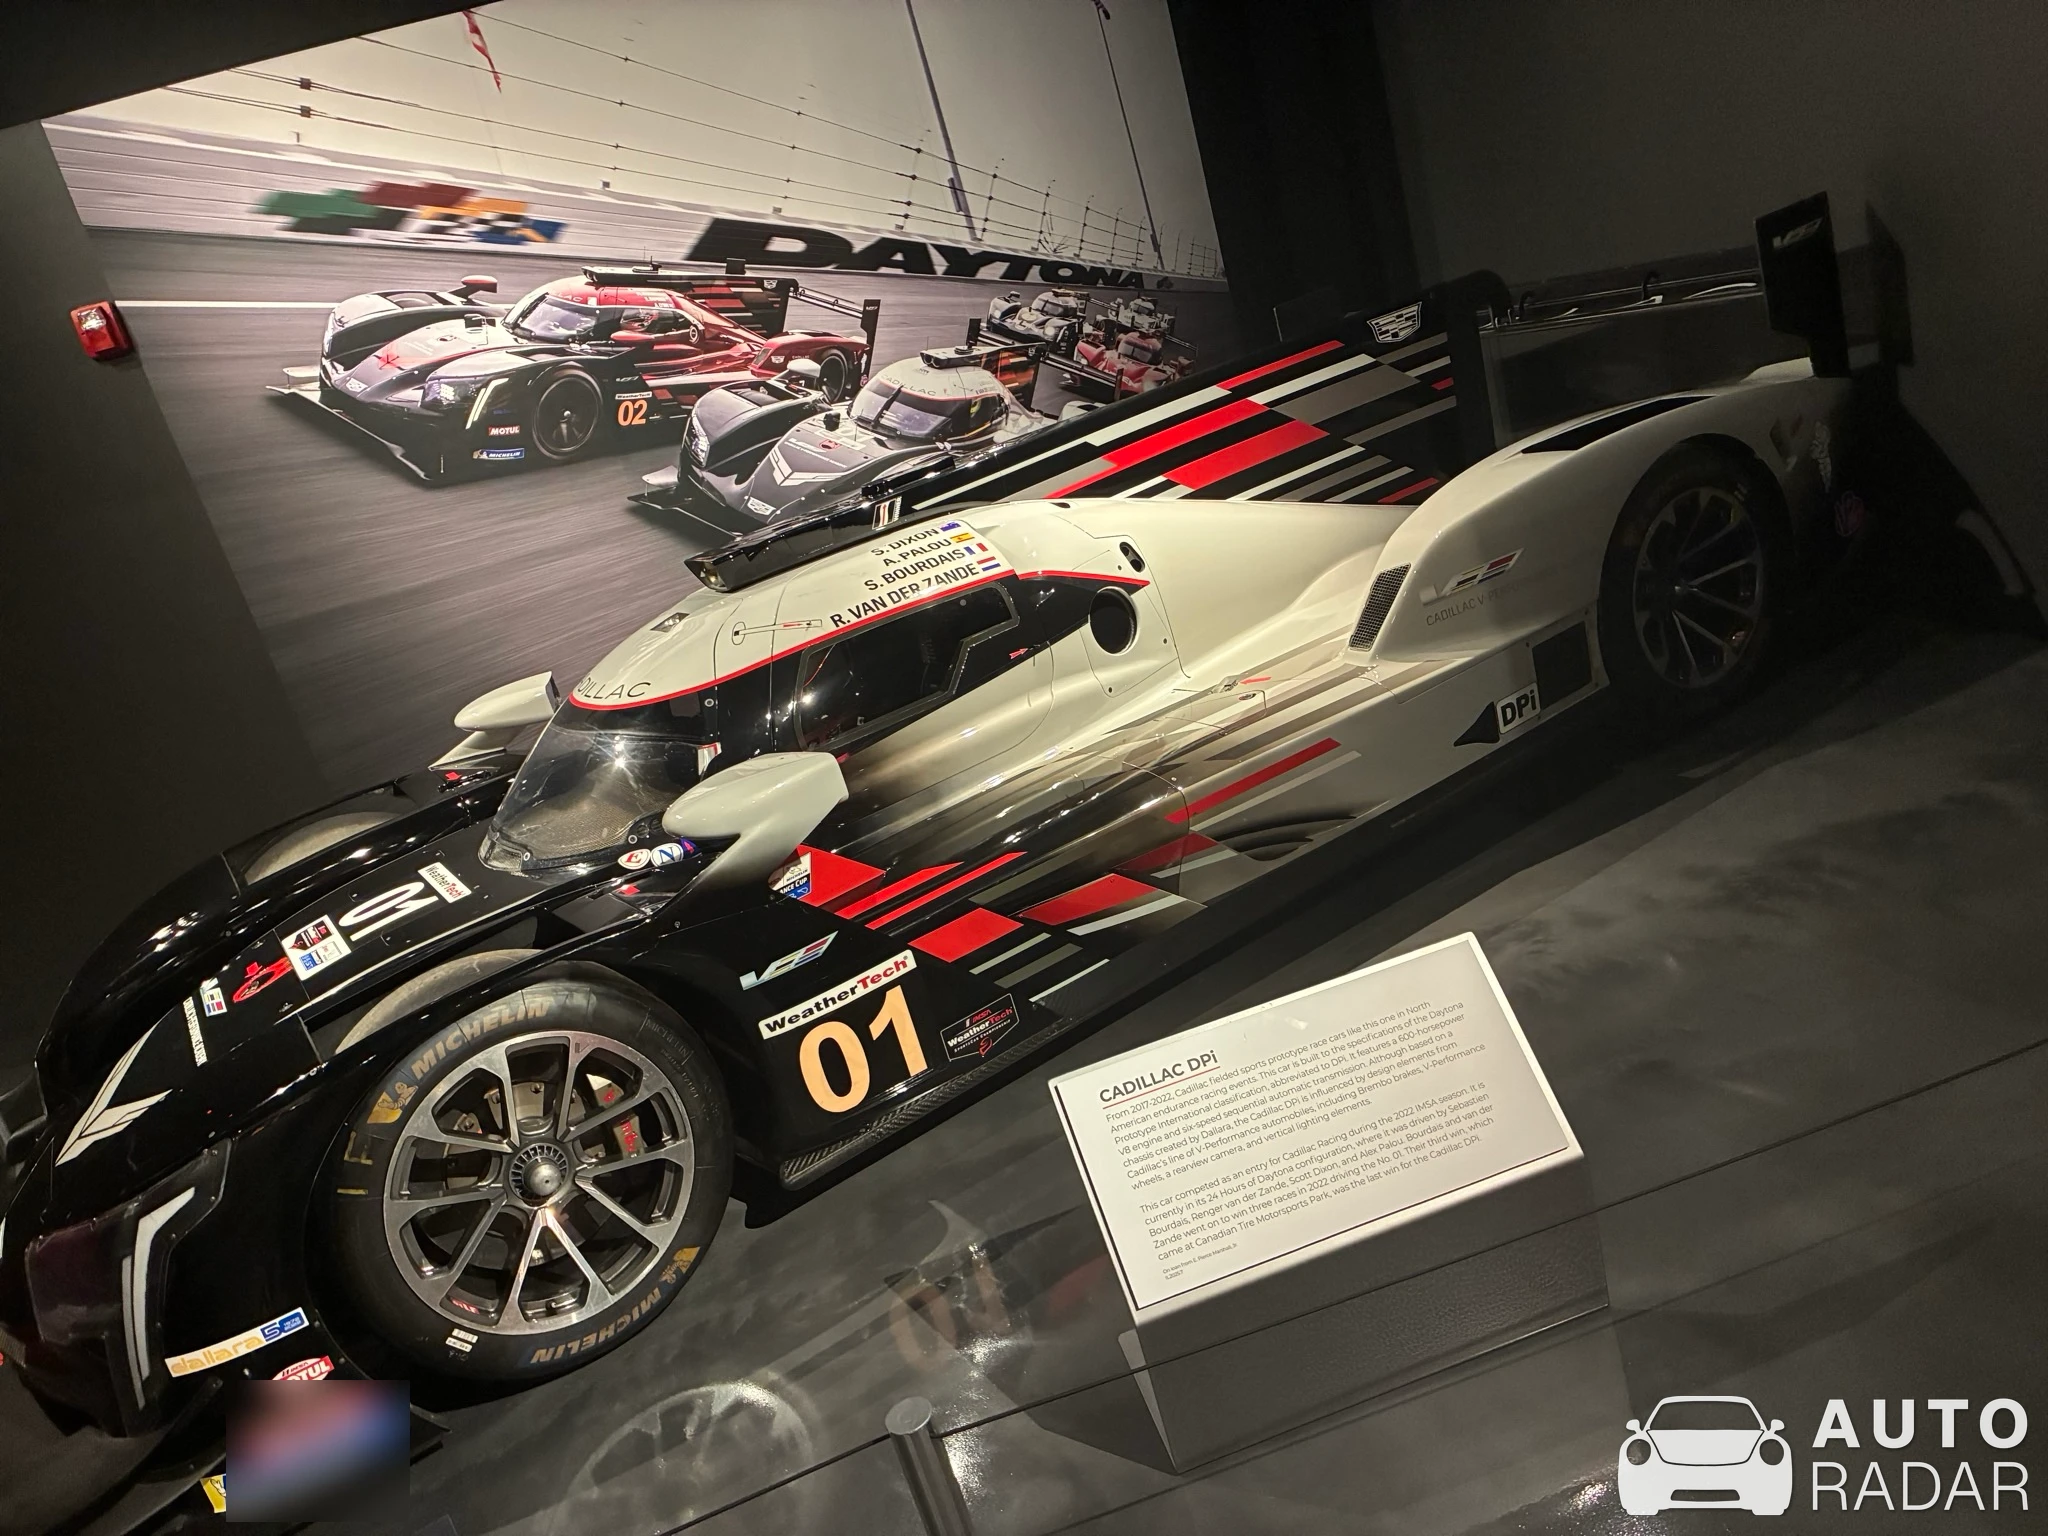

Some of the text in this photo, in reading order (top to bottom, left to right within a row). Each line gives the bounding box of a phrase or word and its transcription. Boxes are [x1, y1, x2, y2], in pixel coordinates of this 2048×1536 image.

[685, 217, 1145, 289] DAYTONA
[490, 425, 521, 437] MOTUL
[617, 400, 648, 427] 02
[488, 450, 522, 459] MICHELIN
[864, 549, 967, 592] S. BOURDAIS
[871, 528, 941, 557] S. DIXON
[883, 538, 953, 568] A. PALOU
[829, 563, 981, 629] R. VAN DER ZANDE
[1426, 598, 1478, 627] CADILLAC
[1501, 689, 1538, 728] DPi
[338, 881, 440, 942] 01
[795, 877, 809, 888] CUP
[765, 957, 909, 1034] WeatherTech
[947, 1007, 1014, 1048] WeatherTech
[411, 1000, 554, 1082] MICHELIN
[799, 985, 929, 1114] 01
[1105, 1001, 1431, 1123] From 2017-2022, Cadillac fielded sports prototype race cars like this one in North
[1111, 1002, 1464, 1134] American endurance racing events. This car is built to the specifications of the Daytona
[1099, 1049, 1218, 1103] CADILLAC DPi
[1117, 1030, 1454, 1156] V8 engine and six-speed sequential automatic transmission. Although based on a
[1167, 1153, 1185, 1164] line
[1185, 1147, 1195, 1158] of
[1194, 1125, 1261, 1154] V-Performance
[1261, 1106, 1317, 1130] automobiles,
[1315, 1090, 1358, 1110] including
[1356, 1078, 1393, 1095] Brembo
[1391, 1067, 1424, 1082] brakes,
[1422, 1044, 1486, 1071] V-Performance
[1131, 1174, 1165, 1190] wheels,
[1172, 1157, 1209, 1176] rearview
[1210, 1145, 1246, 1162] camera,
[1245, 1135, 1264, 1149] and
[1263, 1124, 1296, 1142] vertical
[1295, 1113, 1330, 1131] lighting
[1330, 1098, 1373, 1118] elements.
[1144, 1093, 1490, 1226] currently in its 24 Hours of Daytona configuration, where it was driven by Sebastien
[1148, 1104, 1493, 1238] Bourdais, Renger van der Zande, Scott Dixon, and Alex Palou. Bourdais and van der
[1158, 1134, 1481, 1261] came at Canadian Tire Motorsports Park, was the last win for the Cadillac DPi.
[170, 1337, 264, 1375] dallara
[530, 1286, 662, 1365] MICHELIN
